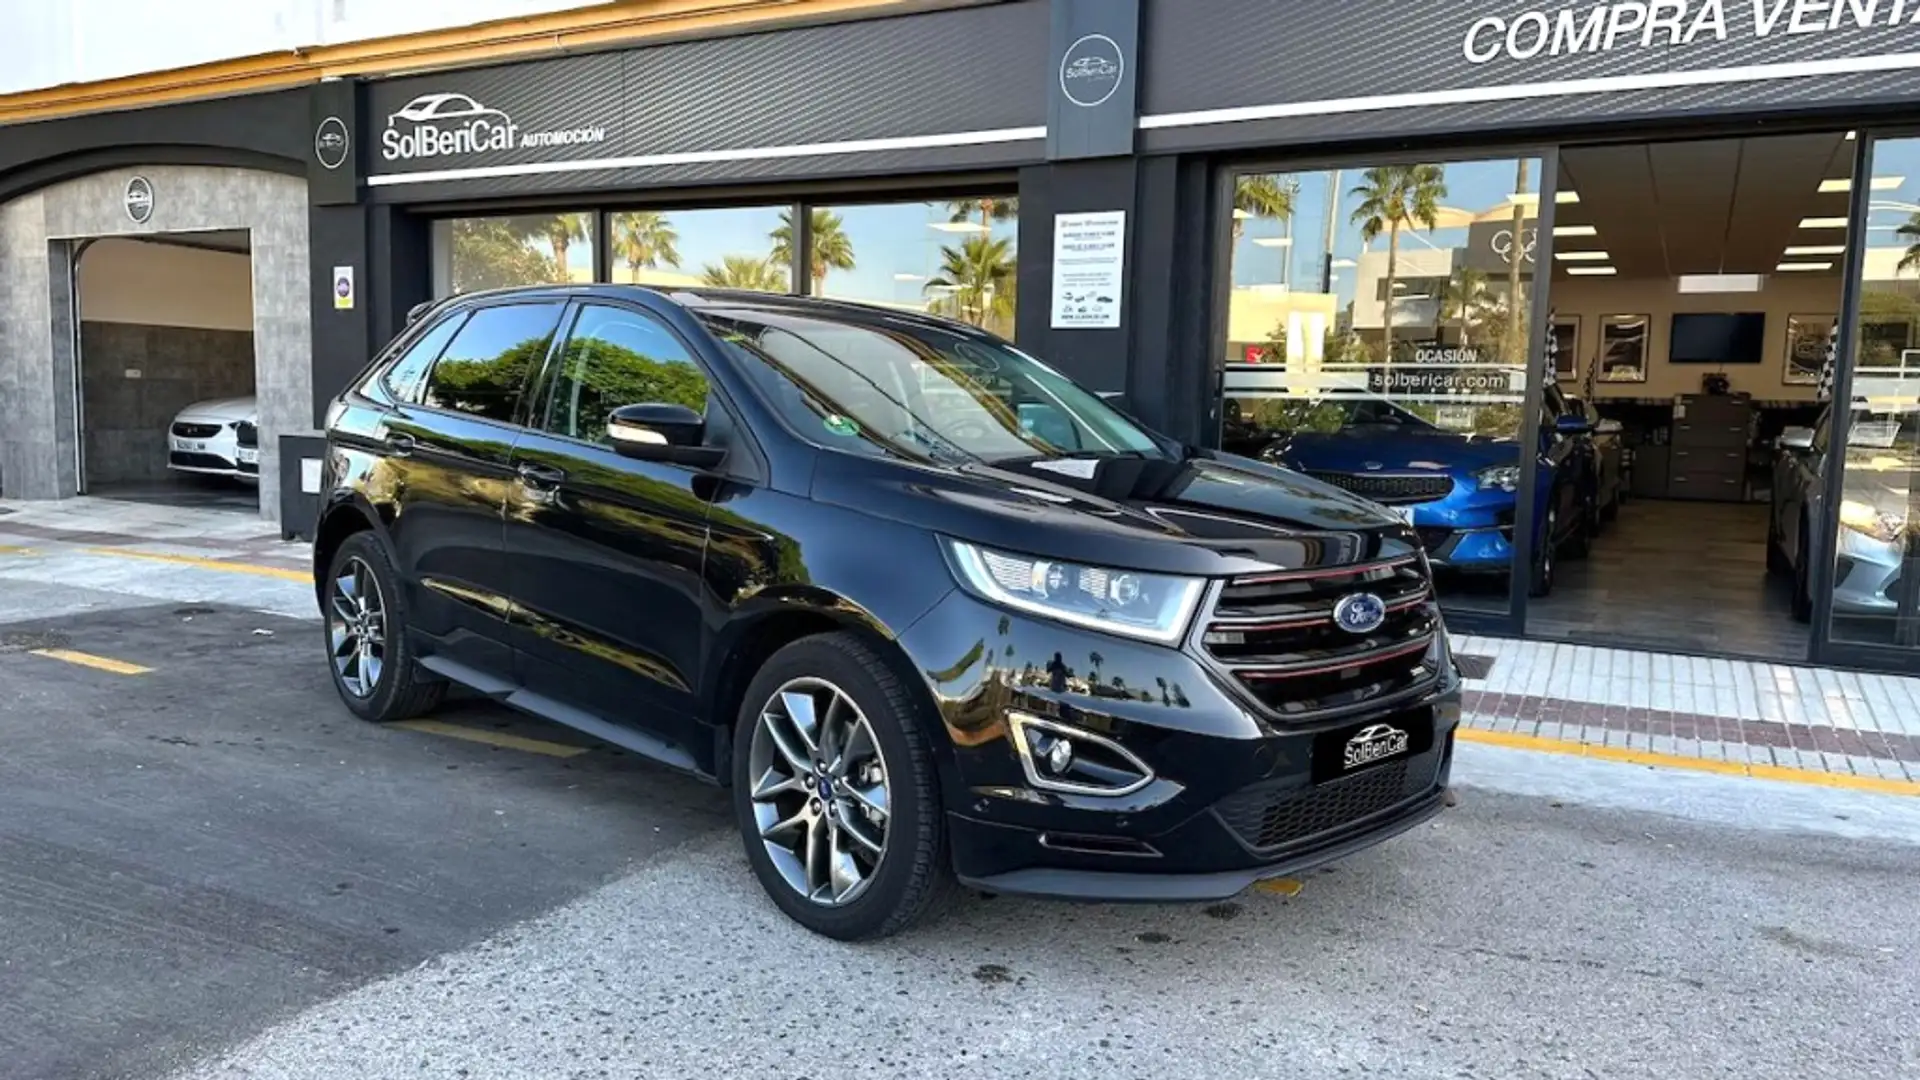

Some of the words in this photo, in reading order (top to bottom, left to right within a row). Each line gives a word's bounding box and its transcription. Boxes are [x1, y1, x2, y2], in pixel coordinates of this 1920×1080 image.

[1463, 0, 1727, 63] COMPRA
[1753, 0, 1920, 37] VEN
[520, 126, 605, 149] AUTOMOCIÓN
[1415, 346, 1477, 361] OCASIÓN
[1374, 372, 1504, 388] solbericar.com
